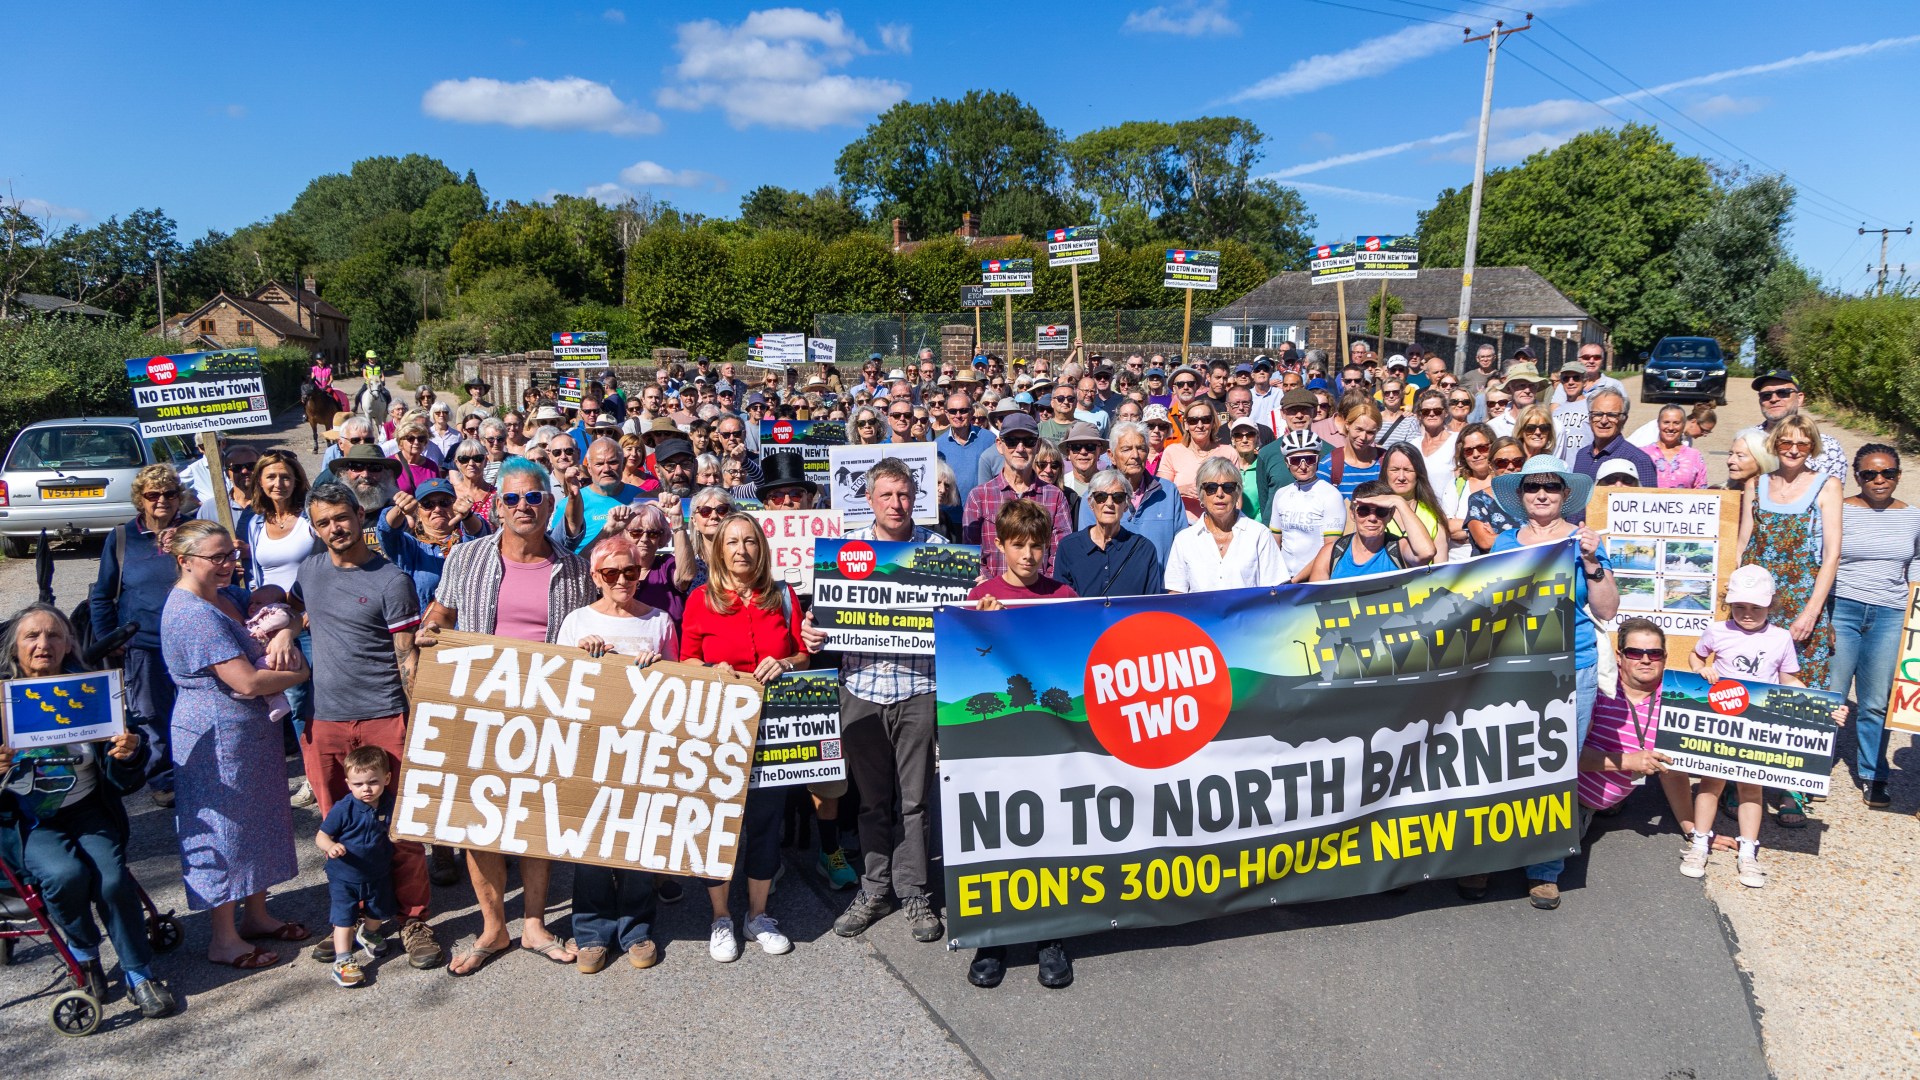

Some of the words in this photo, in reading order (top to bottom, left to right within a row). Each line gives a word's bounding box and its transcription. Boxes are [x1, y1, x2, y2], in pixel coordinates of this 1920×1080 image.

[812, 340, 834, 352] GONE
[148, 362, 174, 373] ROUND
[155, 371, 172, 381] TWO
[138, 389, 158, 404] NO
[161, 386, 196, 402] ETON
[199, 386, 224, 398] NEW
[227, 382, 260, 394] TOWN
[157, 406, 181, 418] JOIN
[182, 404, 199, 414] the
[200, 400, 249, 415] campaign
[145, 414, 268, 434] DontUrbaniseTheDowns.com
[764, 447, 776, 457] NO
[805, 449, 821, 457] NEW
[804, 461, 829, 471] campaig
[1612, 500, 1638, 513] OUR
[1643, 501, 1684, 514] LANES
[1689, 503, 1716, 515] ARE
[784, 515, 840, 537] ETON
[1614, 521, 1638, 533] NOT
[1643, 521, 1705, 535] SUITABLE
[771, 547, 814, 569] ESS
[840, 550, 873, 562] ROUND
[847, 562, 868, 573] TWO
[819, 584, 843, 602] NO
[848, 585, 891, 604] ETON
[896, 591, 928, 604] NEW
[836, 611, 866, 625] JOIN
[868, 611, 889, 626] the
[892, 616, 934, 630] campa
[1676, 617, 1709, 630] CARS
[1091, 646, 1217, 704] ROUND
[437, 644, 602, 721] TAKE
[622, 665, 761, 747] YOUR
[1709, 686, 1745, 703] ROUND
[1719, 699, 1742, 711] TWO
[1121, 694, 1199, 743] TWO
[46, 732, 66, 740] wunt
[80, 729, 98, 737] druv
[758, 724, 789, 740] NEW
[793, 720, 836, 737] TOWN
[1664, 711, 1690, 729] NO
[1694, 717, 1744, 739] ETON
[1749, 728, 1782, 745] NEW
[1785, 733, 1828, 752] TOWN
[755, 745, 817, 762] campaign
[1679, 737, 1711, 753] JOIN
[1714, 743, 1736, 757] the
[1738, 749, 1804, 768] campaign
[592, 726, 748, 800] MESS
[749, 766, 840, 783] eTheDowns.com
[1672, 757, 1824, 790] ntUrbaniseTheDowns.com
[959, 788, 1044, 852] NO
[1061, 785, 1135, 845] TO
[1153, 757, 1345, 838] NORTH
[1361, 716, 1568, 805] BARNES
[396, 768, 743, 878] ELSEWHERE
[1121, 825, 1361, 901] 3000-HOUSE
[1372, 809, 1457, 861] NEW
[1465, 791, 1572, 846] TOWN
